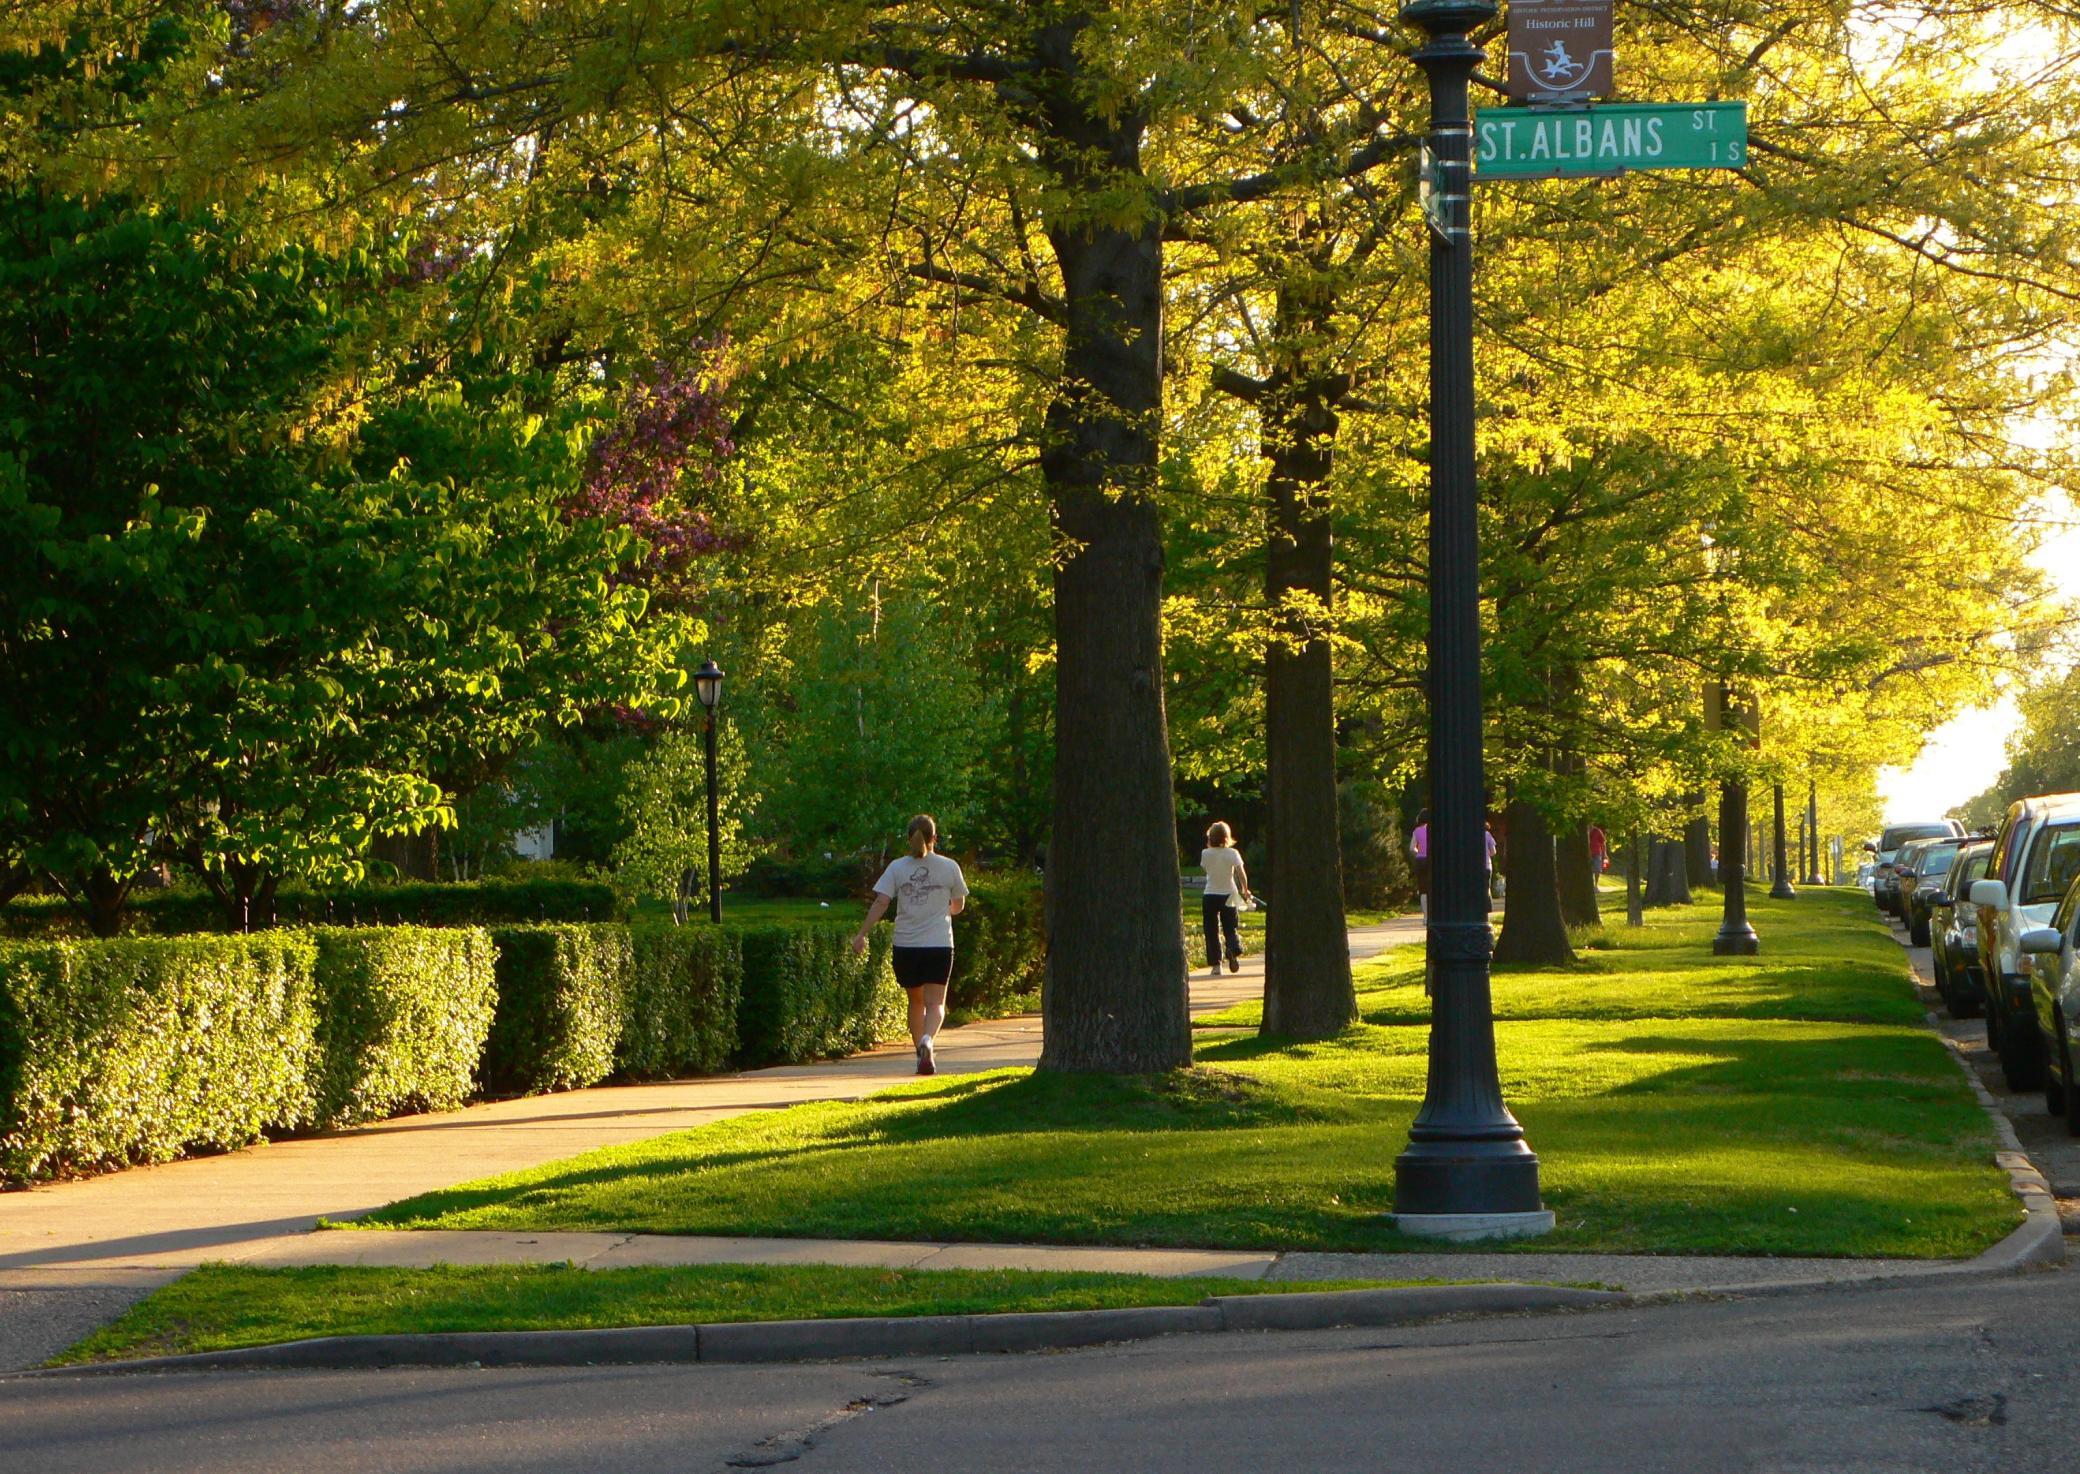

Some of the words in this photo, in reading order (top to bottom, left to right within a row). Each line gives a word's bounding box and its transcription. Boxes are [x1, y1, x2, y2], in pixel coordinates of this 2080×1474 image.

[1526, 18, 1570, 29] Historic
[1574, 17, 1595, 28] Hill
[1692, 110, 1717, 130] ST
